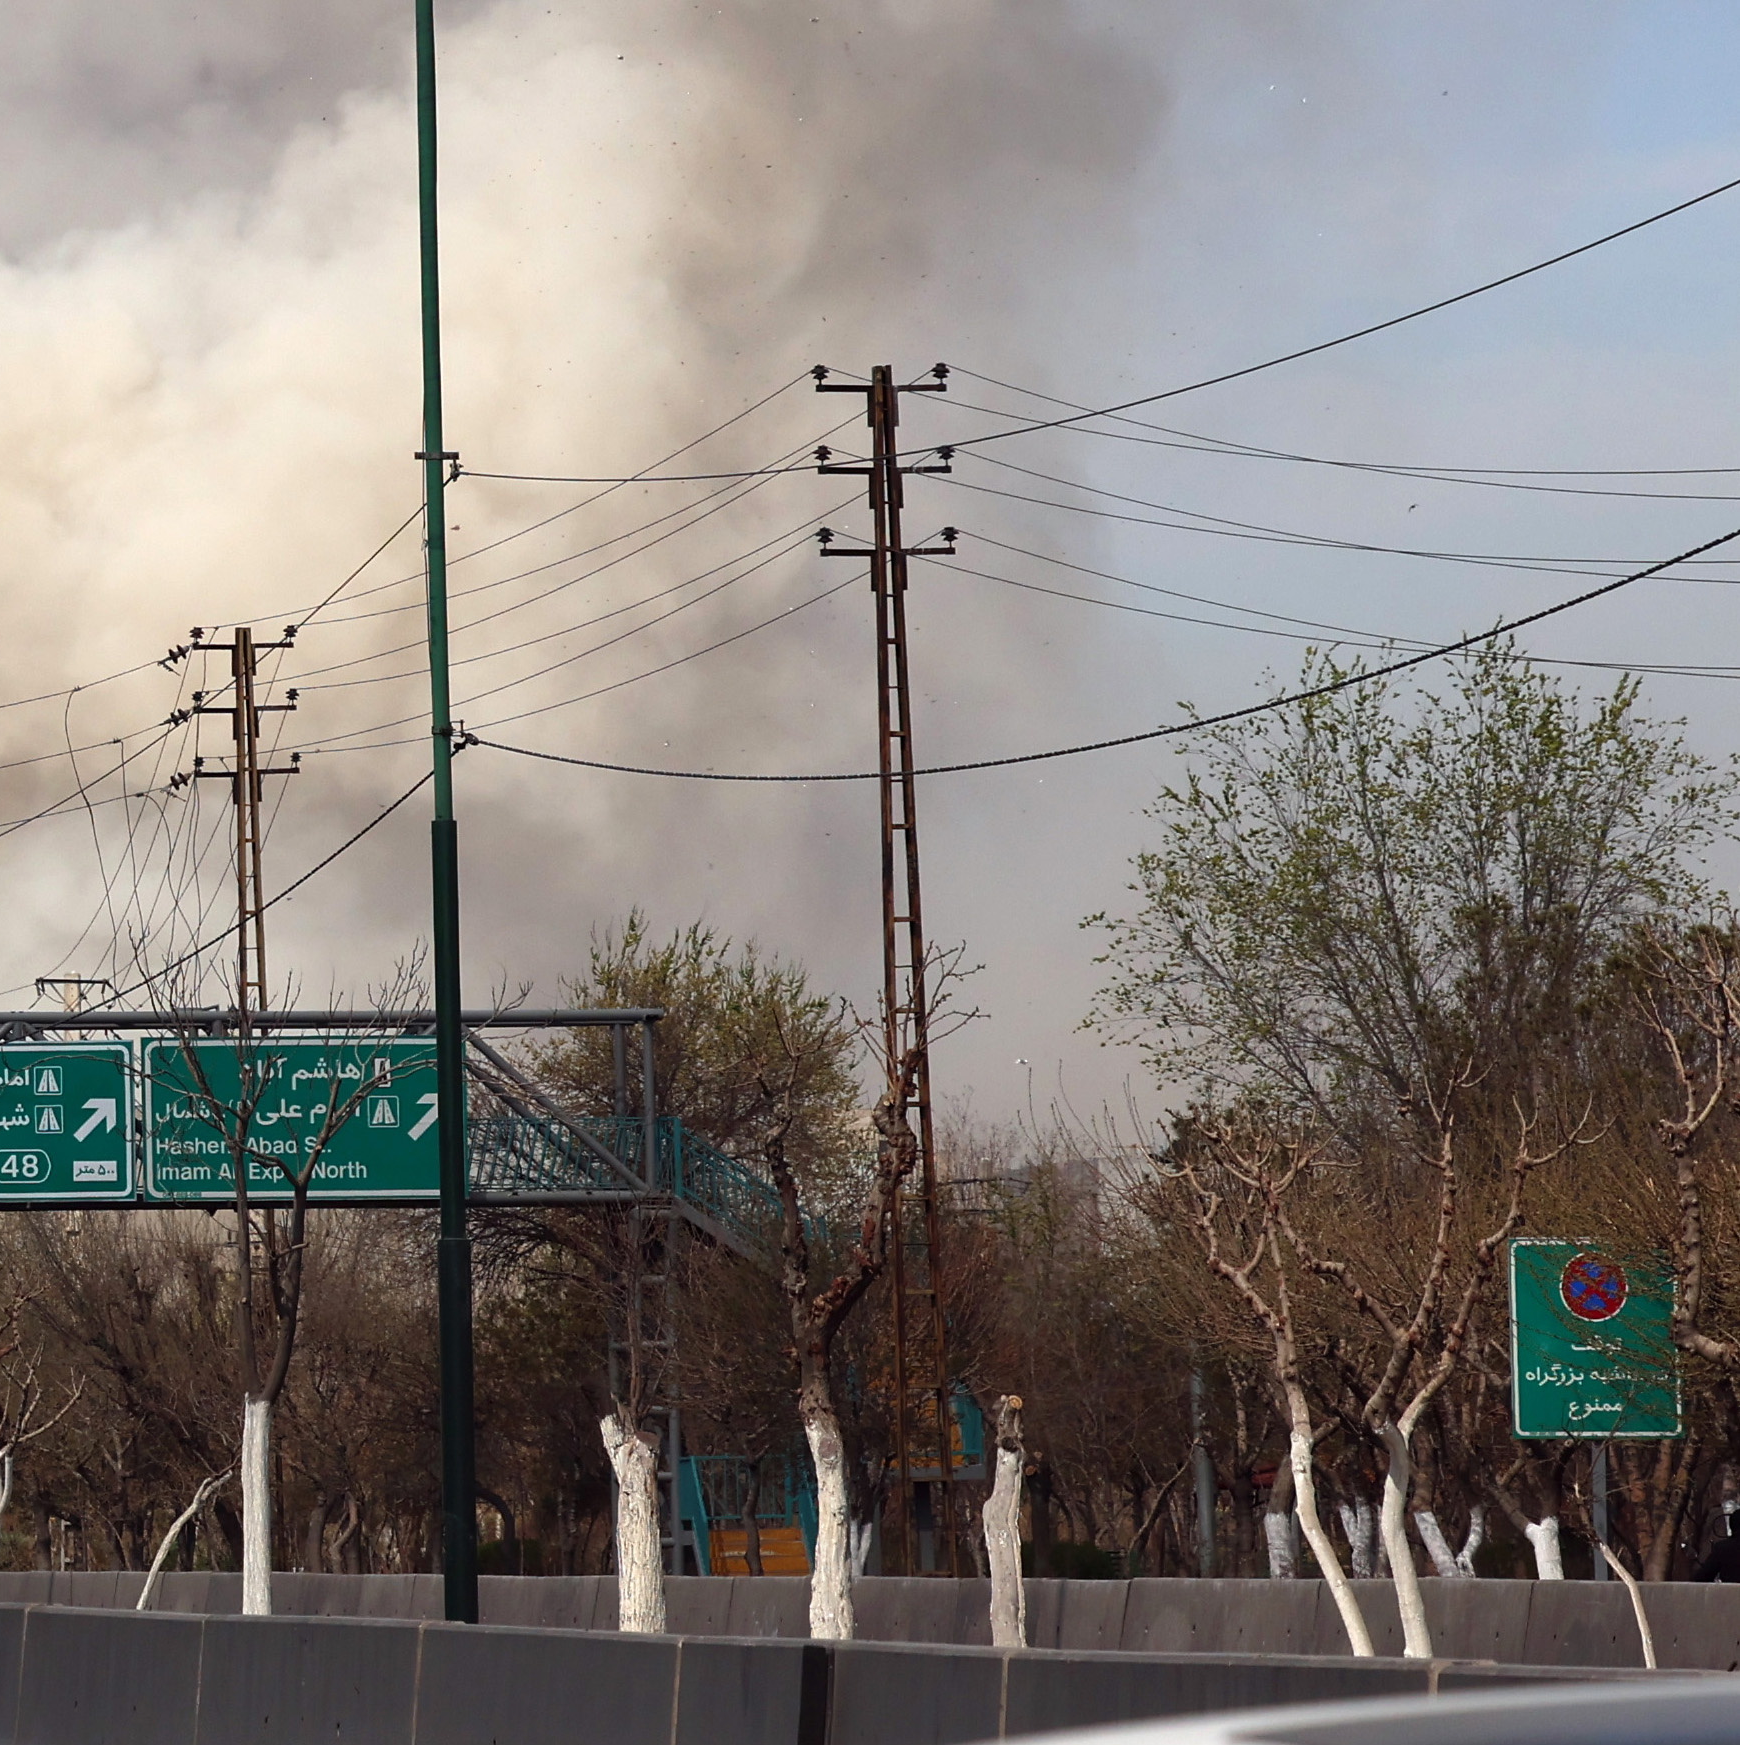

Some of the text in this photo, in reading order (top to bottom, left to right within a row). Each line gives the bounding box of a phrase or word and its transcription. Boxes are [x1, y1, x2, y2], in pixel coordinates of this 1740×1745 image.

[292, 1057, 361, 1091] هاشم
[255, 1098, 303, 1126] علی
[247, 1137, 297, 1155] Abad
[304, 1136, 332, 1154] S.
[1, 1154, 39, 1178] 48
[76, 1164, 115, 1177] ۵۰۰ متر
[157, 1163, 211, 1180] Imam
[218, 1163, 237, 1180] Al
[311, 1160, 368, 1179] North
[1525, 1363, 1584, 1386] بزرگراه
[1568, 1398, 1622, 1421] ممنوع
